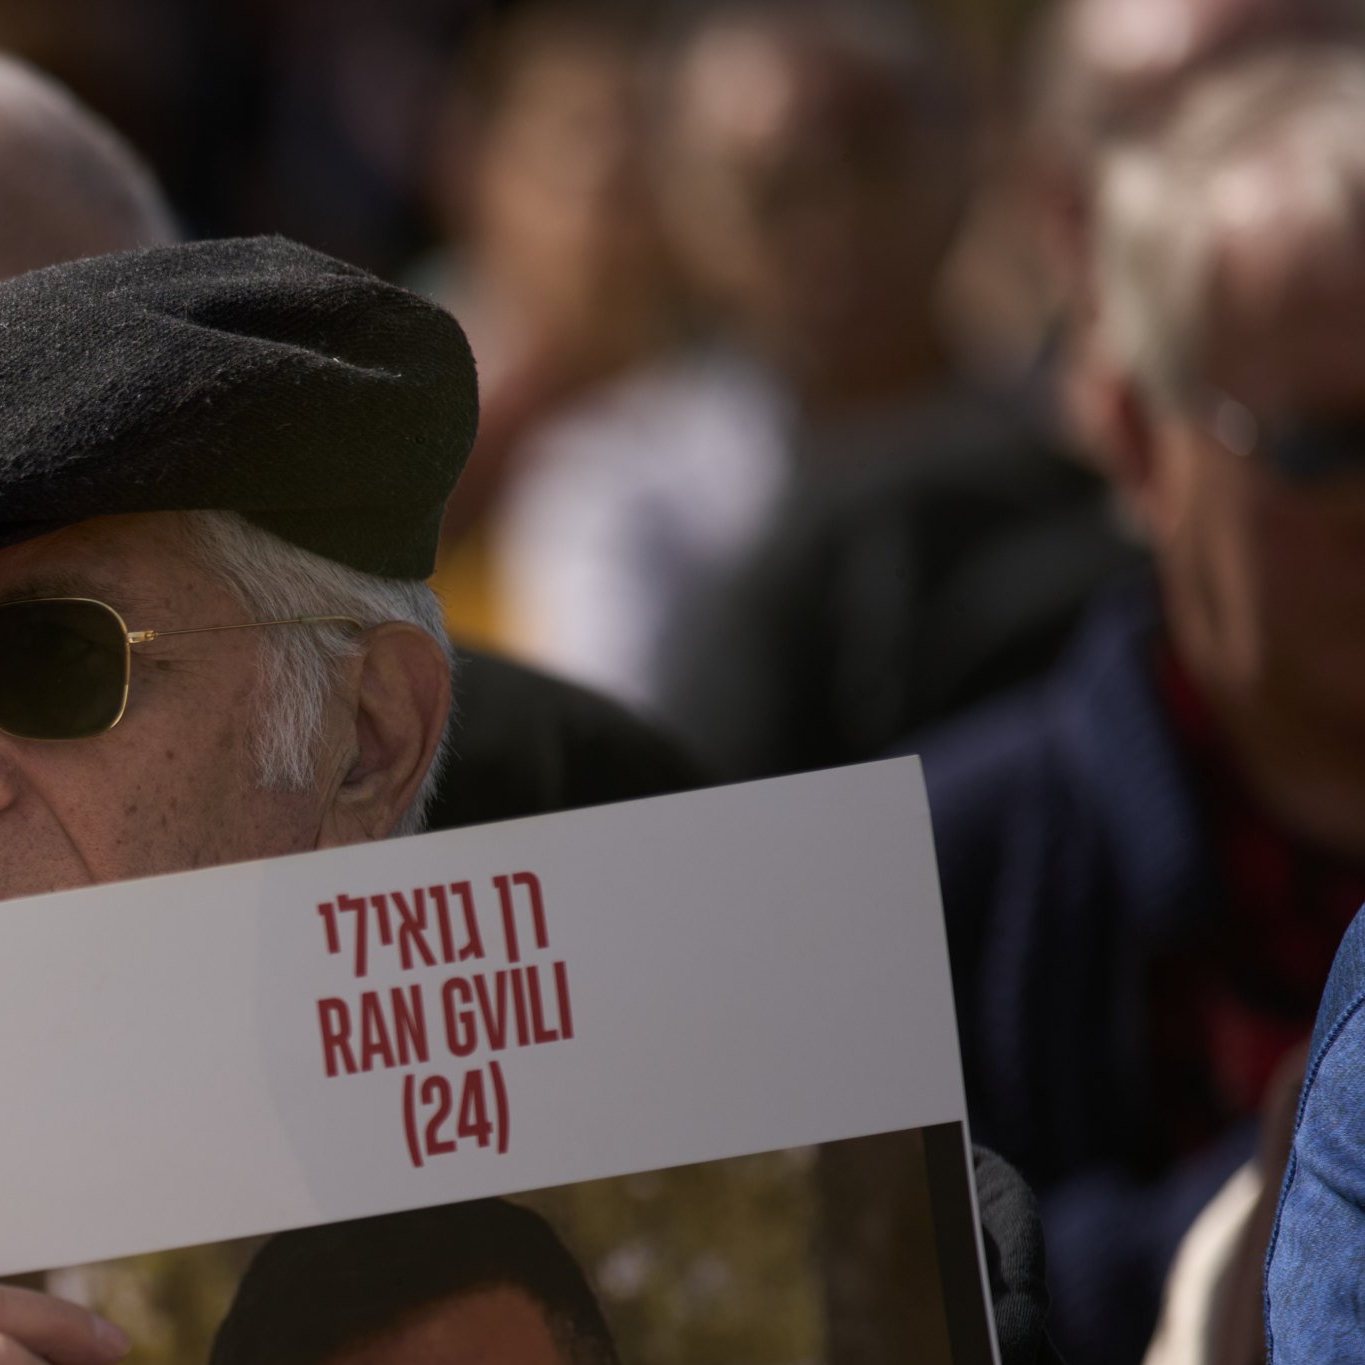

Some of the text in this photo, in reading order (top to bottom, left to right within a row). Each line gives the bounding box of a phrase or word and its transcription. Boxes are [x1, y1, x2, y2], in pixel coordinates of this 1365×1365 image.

[317, 871, 549, 978] רן גואילי
[316, 961, 574, 1078] RAN GVILI
[403, 1060, 510, 1168] (24)
